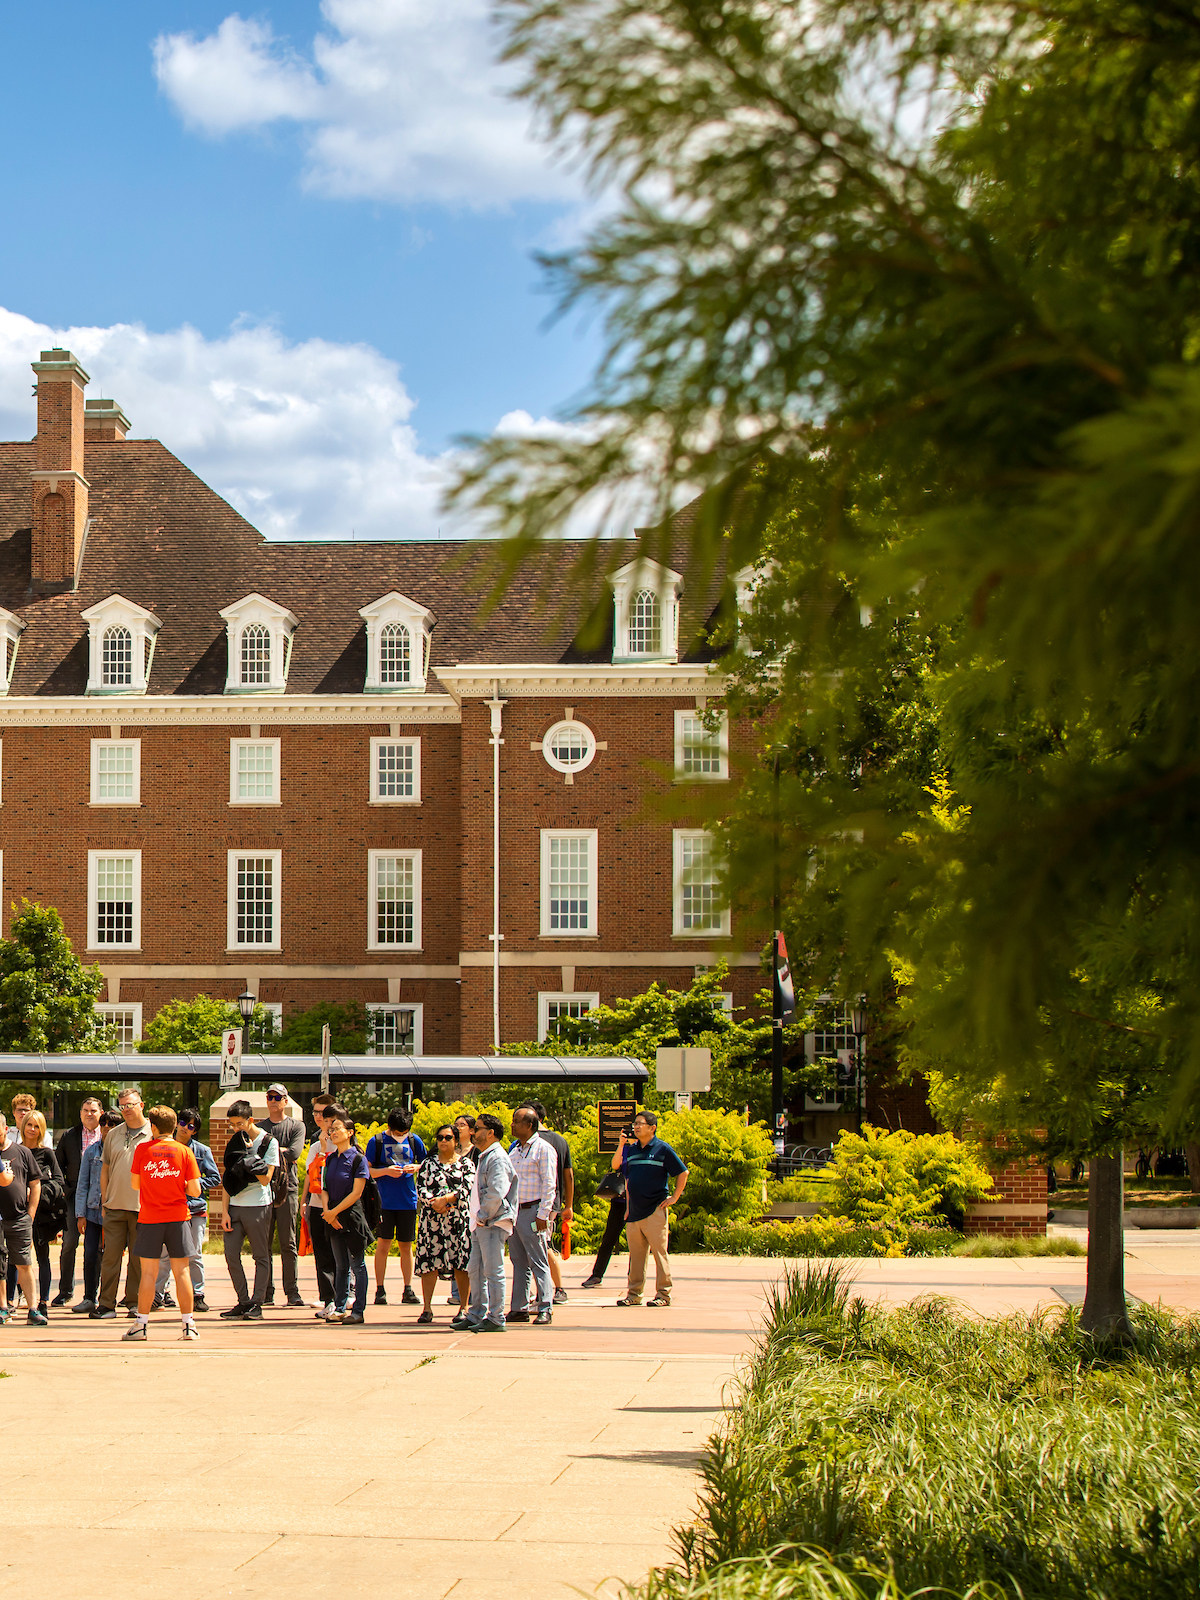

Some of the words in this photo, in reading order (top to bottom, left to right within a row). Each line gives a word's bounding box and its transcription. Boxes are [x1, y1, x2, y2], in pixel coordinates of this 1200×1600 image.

[144, 1160, 157, 1171] Ask
[158, 1160, 170, 1169] Me
[150, 1168, 180, 1179] Anything
